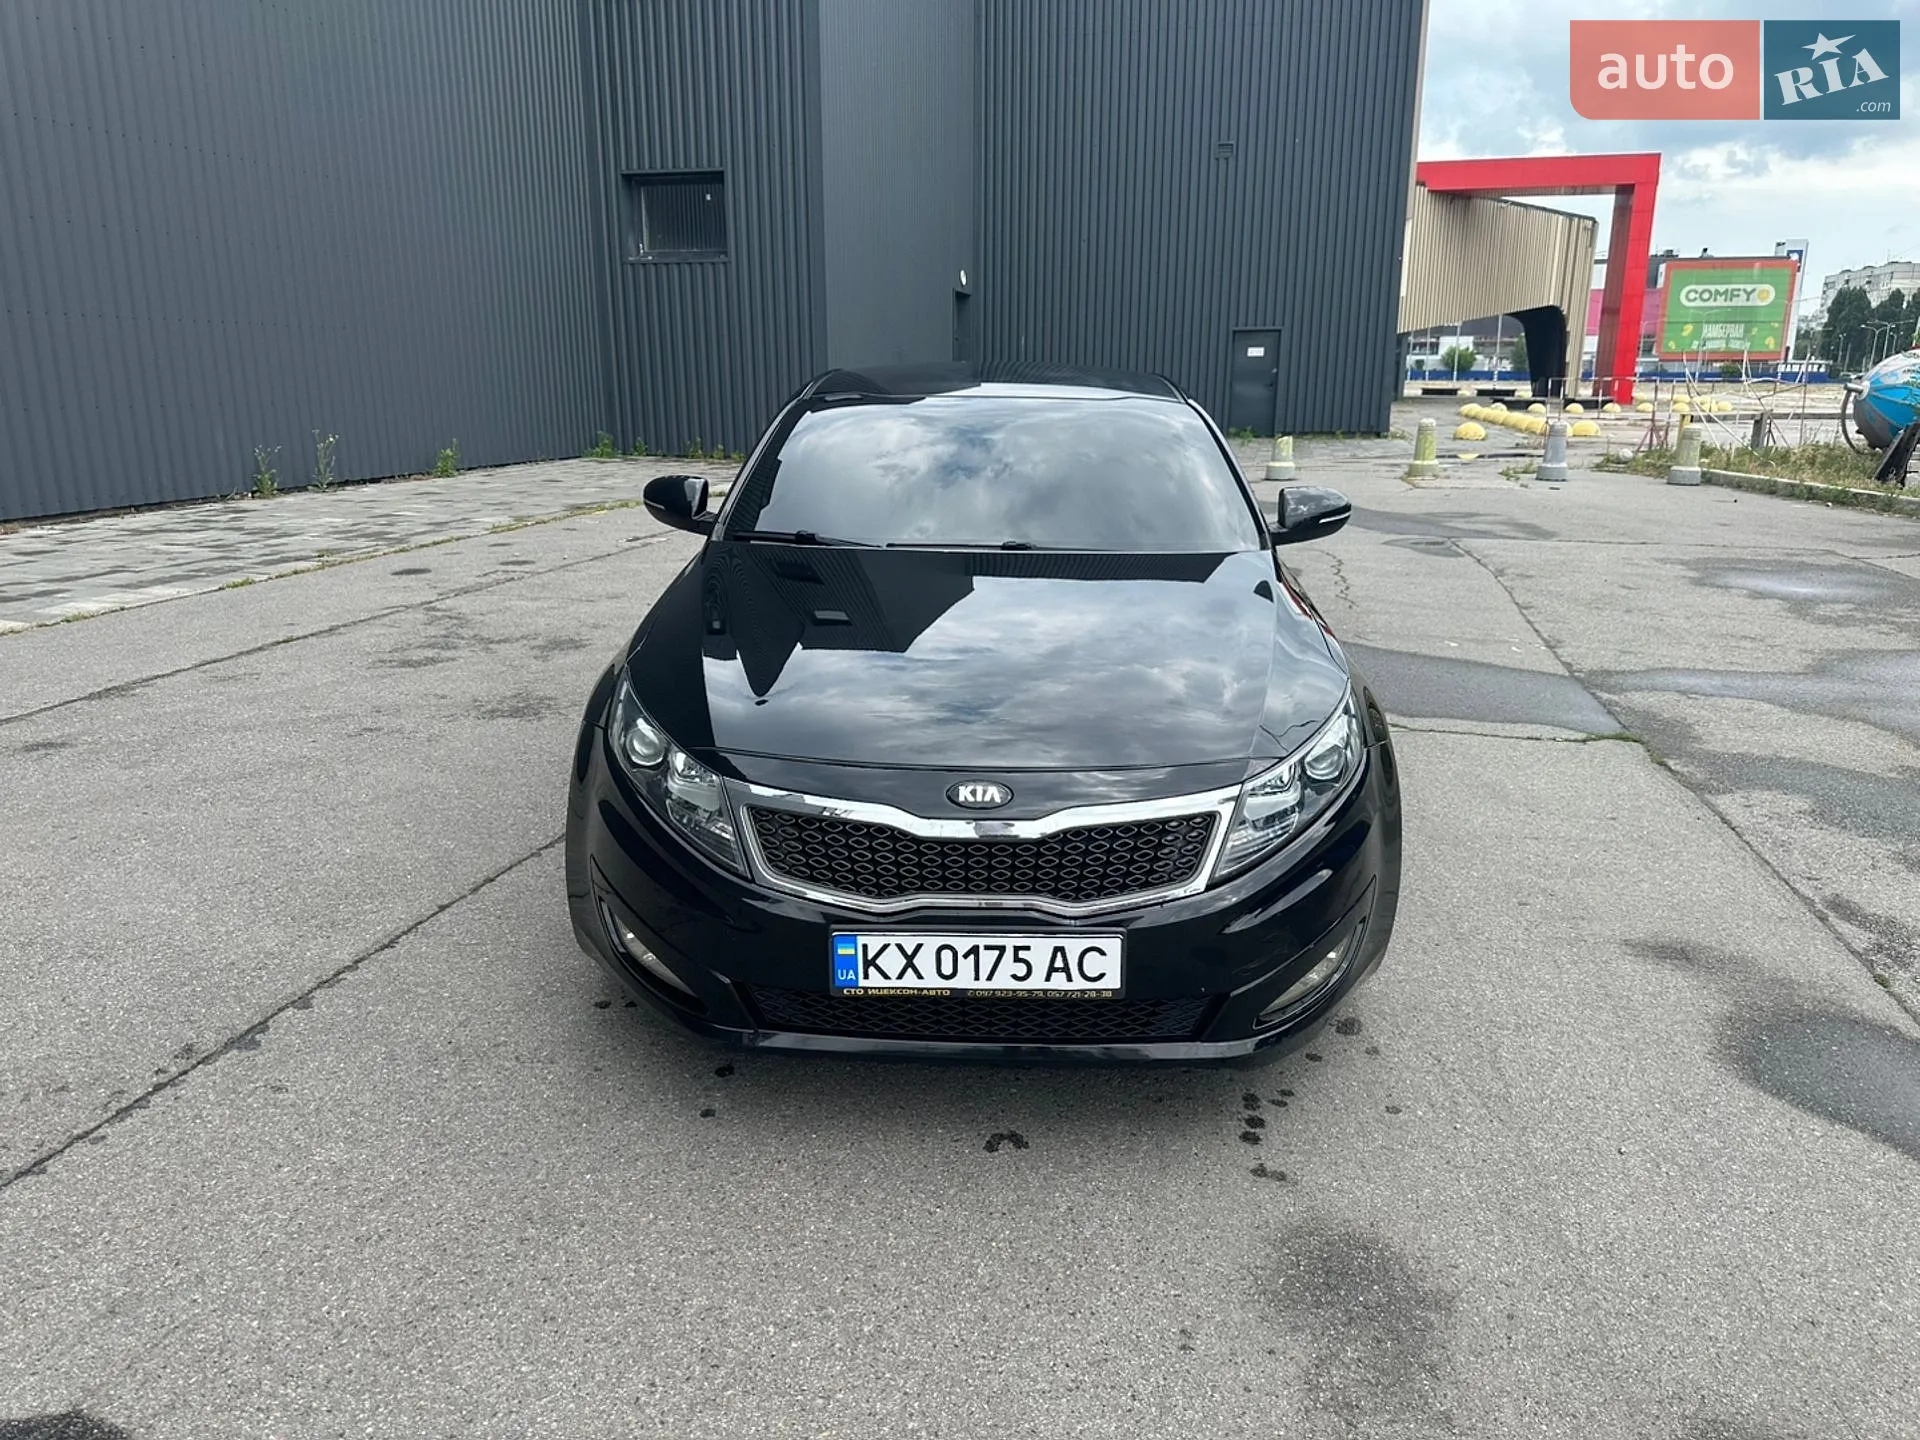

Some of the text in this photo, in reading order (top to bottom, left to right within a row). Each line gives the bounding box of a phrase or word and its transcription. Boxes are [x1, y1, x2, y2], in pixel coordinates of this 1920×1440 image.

[1685, 288, 1757, 303] COMFY
[958, 785, 1001, 803] KIA
[861, 942, 1108, 982] KX 0175 AC
[837, 969, 857, 980] UA
